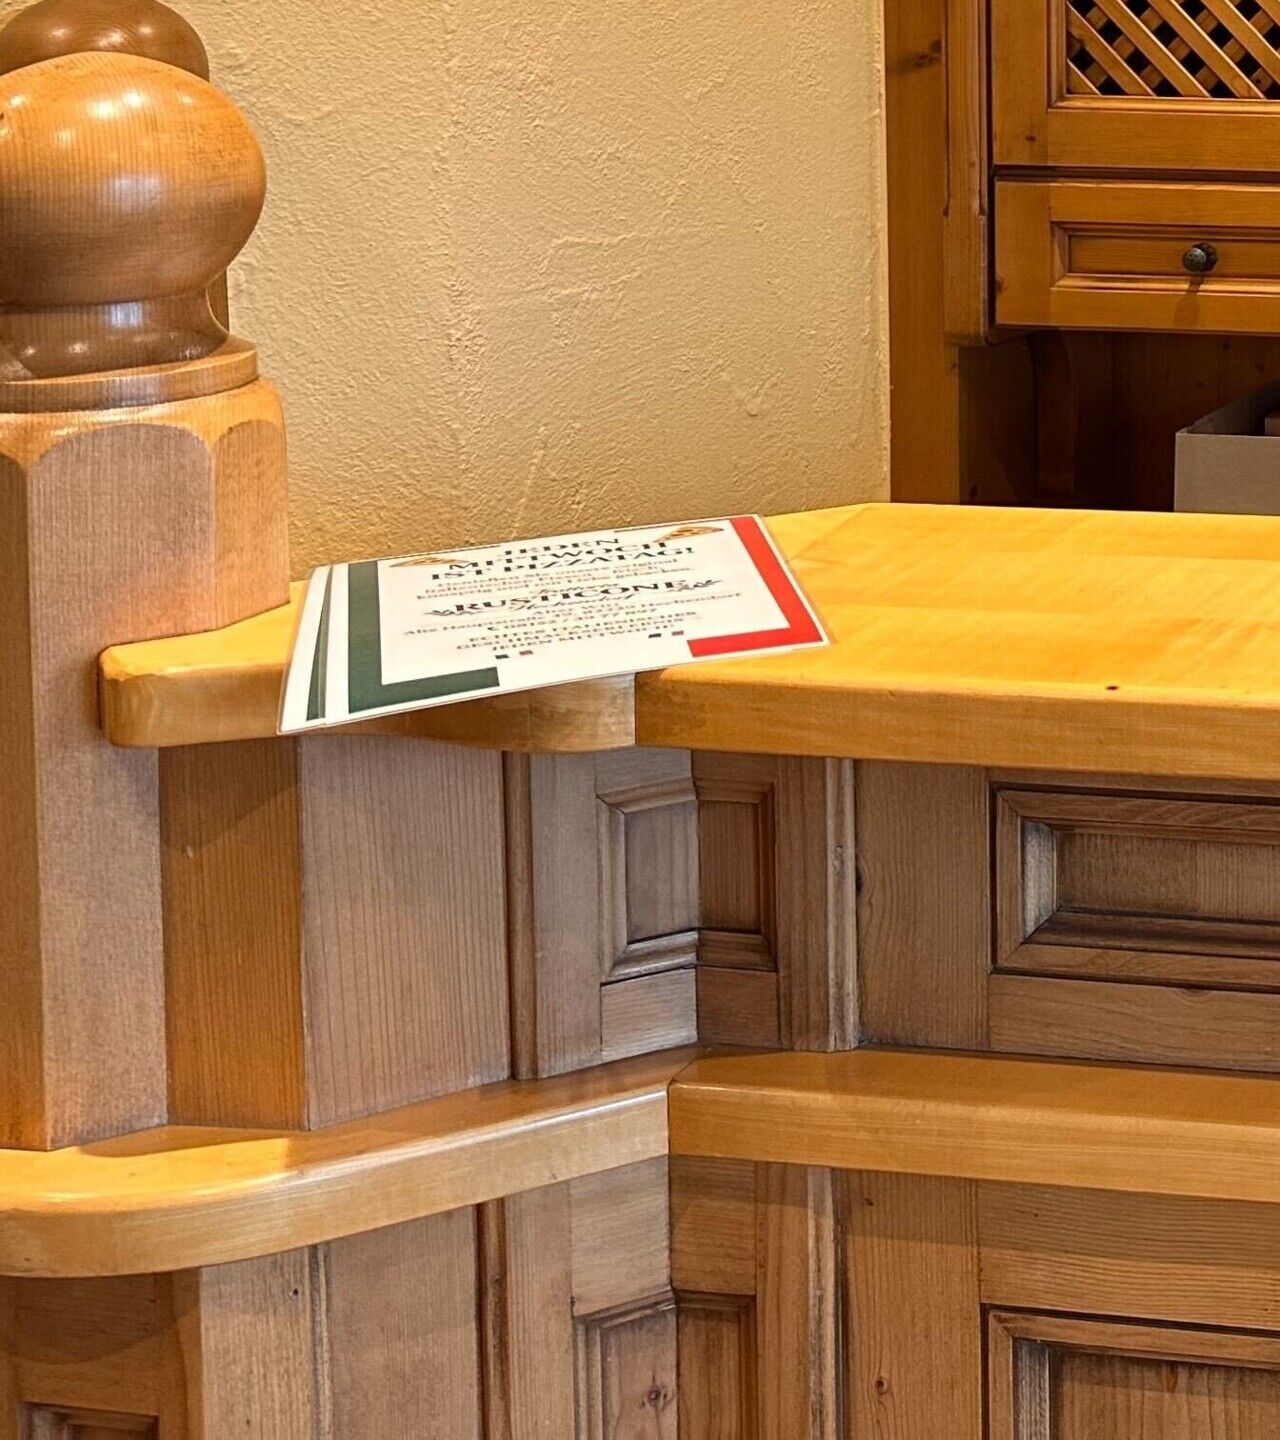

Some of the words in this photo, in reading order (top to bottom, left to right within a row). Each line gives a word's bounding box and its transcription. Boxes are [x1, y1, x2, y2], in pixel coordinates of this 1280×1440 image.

[450, 542, 667, 569] MITTWOCH
[499, 539, 619, 555] JEDEN
[431, 568, 492, 579] IST
[504, 548, 693, 571] PIZZATAG!
[455, 579, 688, 611] RUSTICONE
